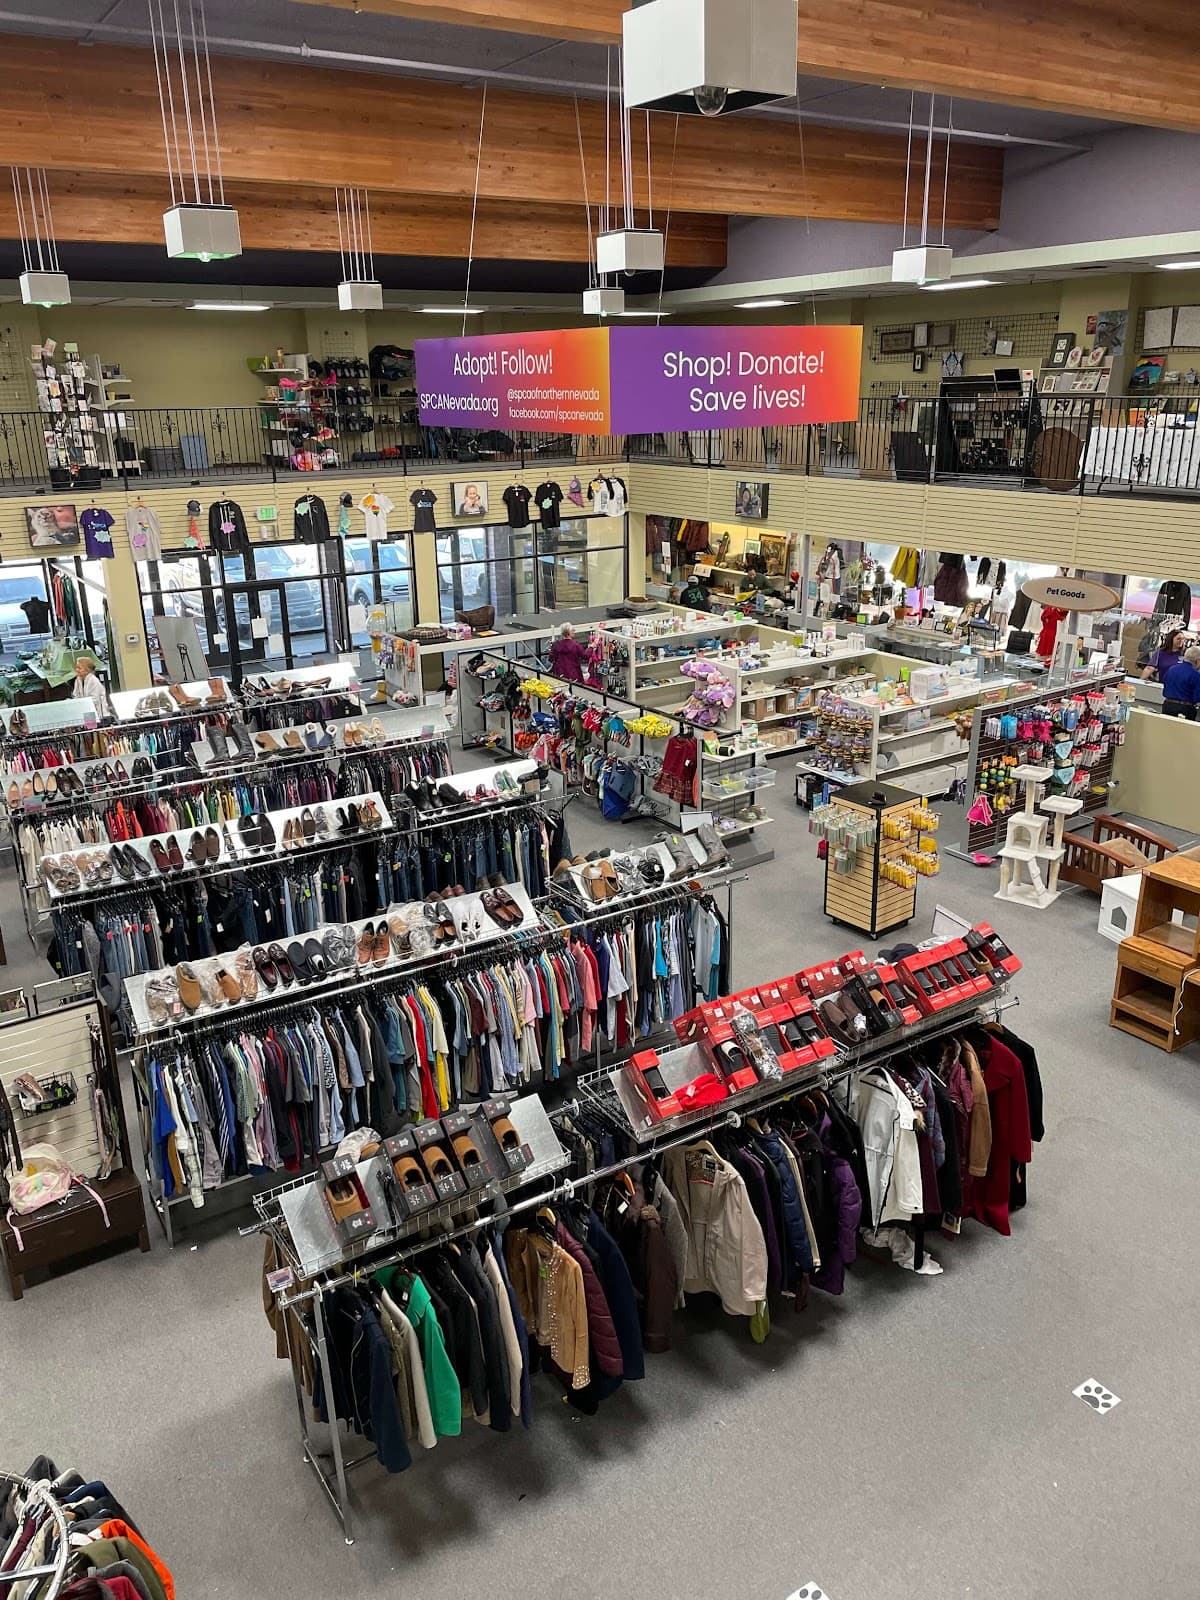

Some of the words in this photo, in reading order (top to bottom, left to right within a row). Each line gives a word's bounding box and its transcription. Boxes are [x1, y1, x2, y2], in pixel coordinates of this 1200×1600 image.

[453, 351, 498, 383] Adopt!
[501, 349, 553, 375] Follow!
[663, 350, 731, 384] Shop!
[738, 350, 825, 376] Donate!
[420, 392, 499, 417] SPCANevada.org
[507, 388, 600, 402] @spcaofnorthernnevada
[689, 387, 747, 412] Save
[753, 384, 806, 409] lives!
[508, 405, 604, 422] facebook.com/spcanevada
[689, 590, 704, 604] 34
[1046, 587, 1059, 595] Pet
[1060, 589, 1086, 599] Goods
